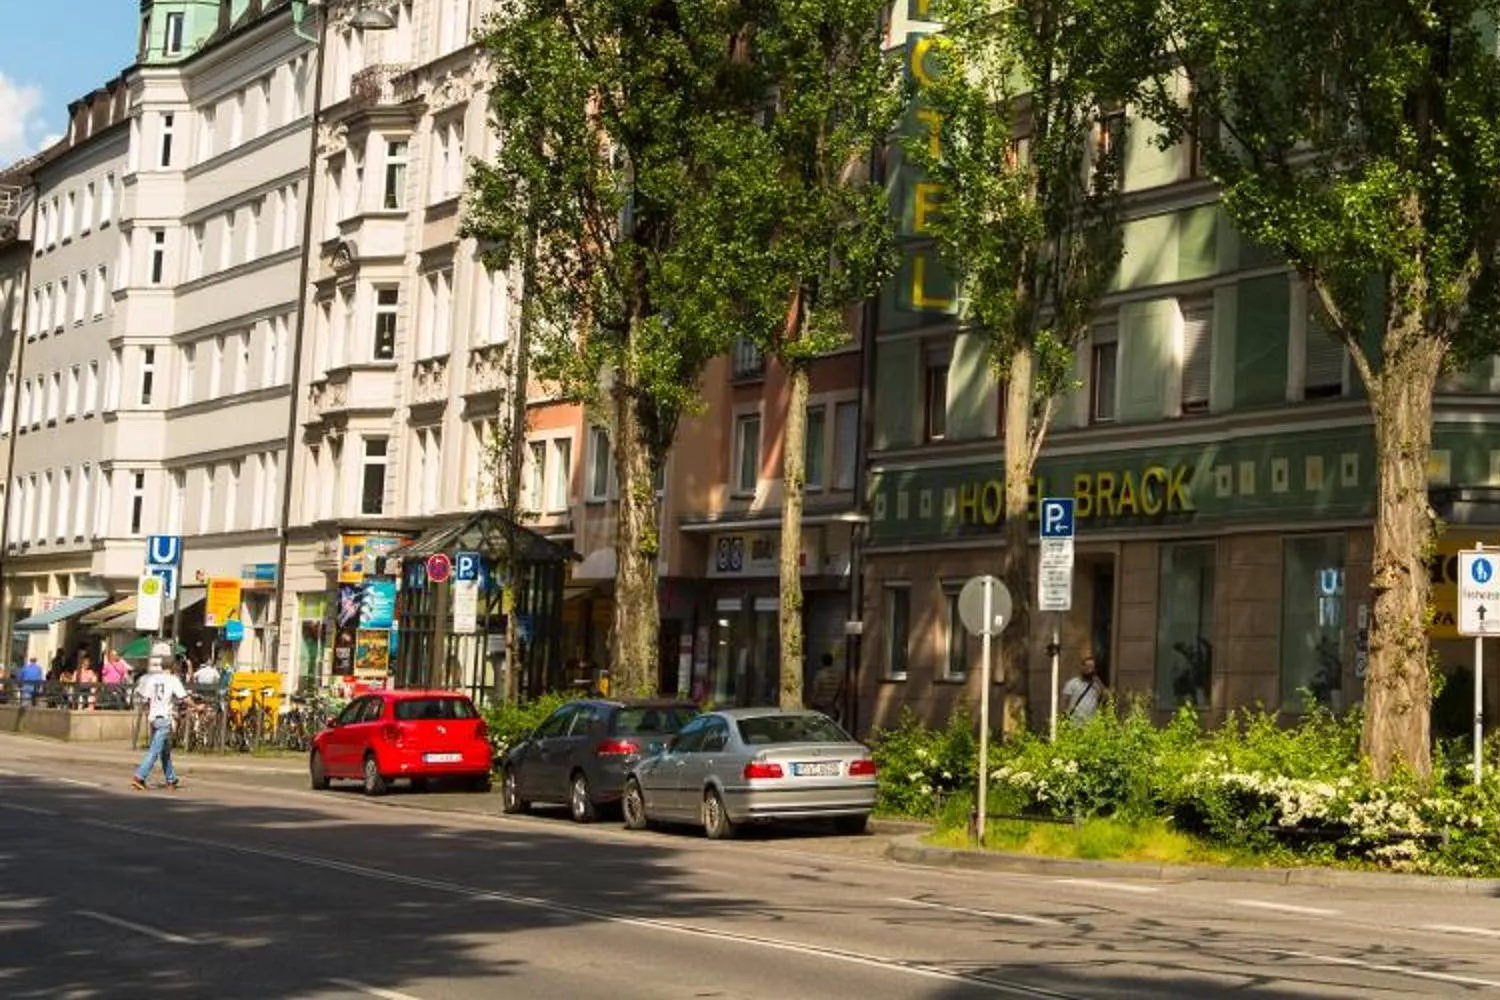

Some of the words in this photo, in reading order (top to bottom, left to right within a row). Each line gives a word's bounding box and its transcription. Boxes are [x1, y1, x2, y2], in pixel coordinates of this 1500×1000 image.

[1074, 465, 1192, 518] BRACK
[1045, 503, 1064, 533] P
[152, 536, 176, 562] U
[460, 556, 472, 579] P
